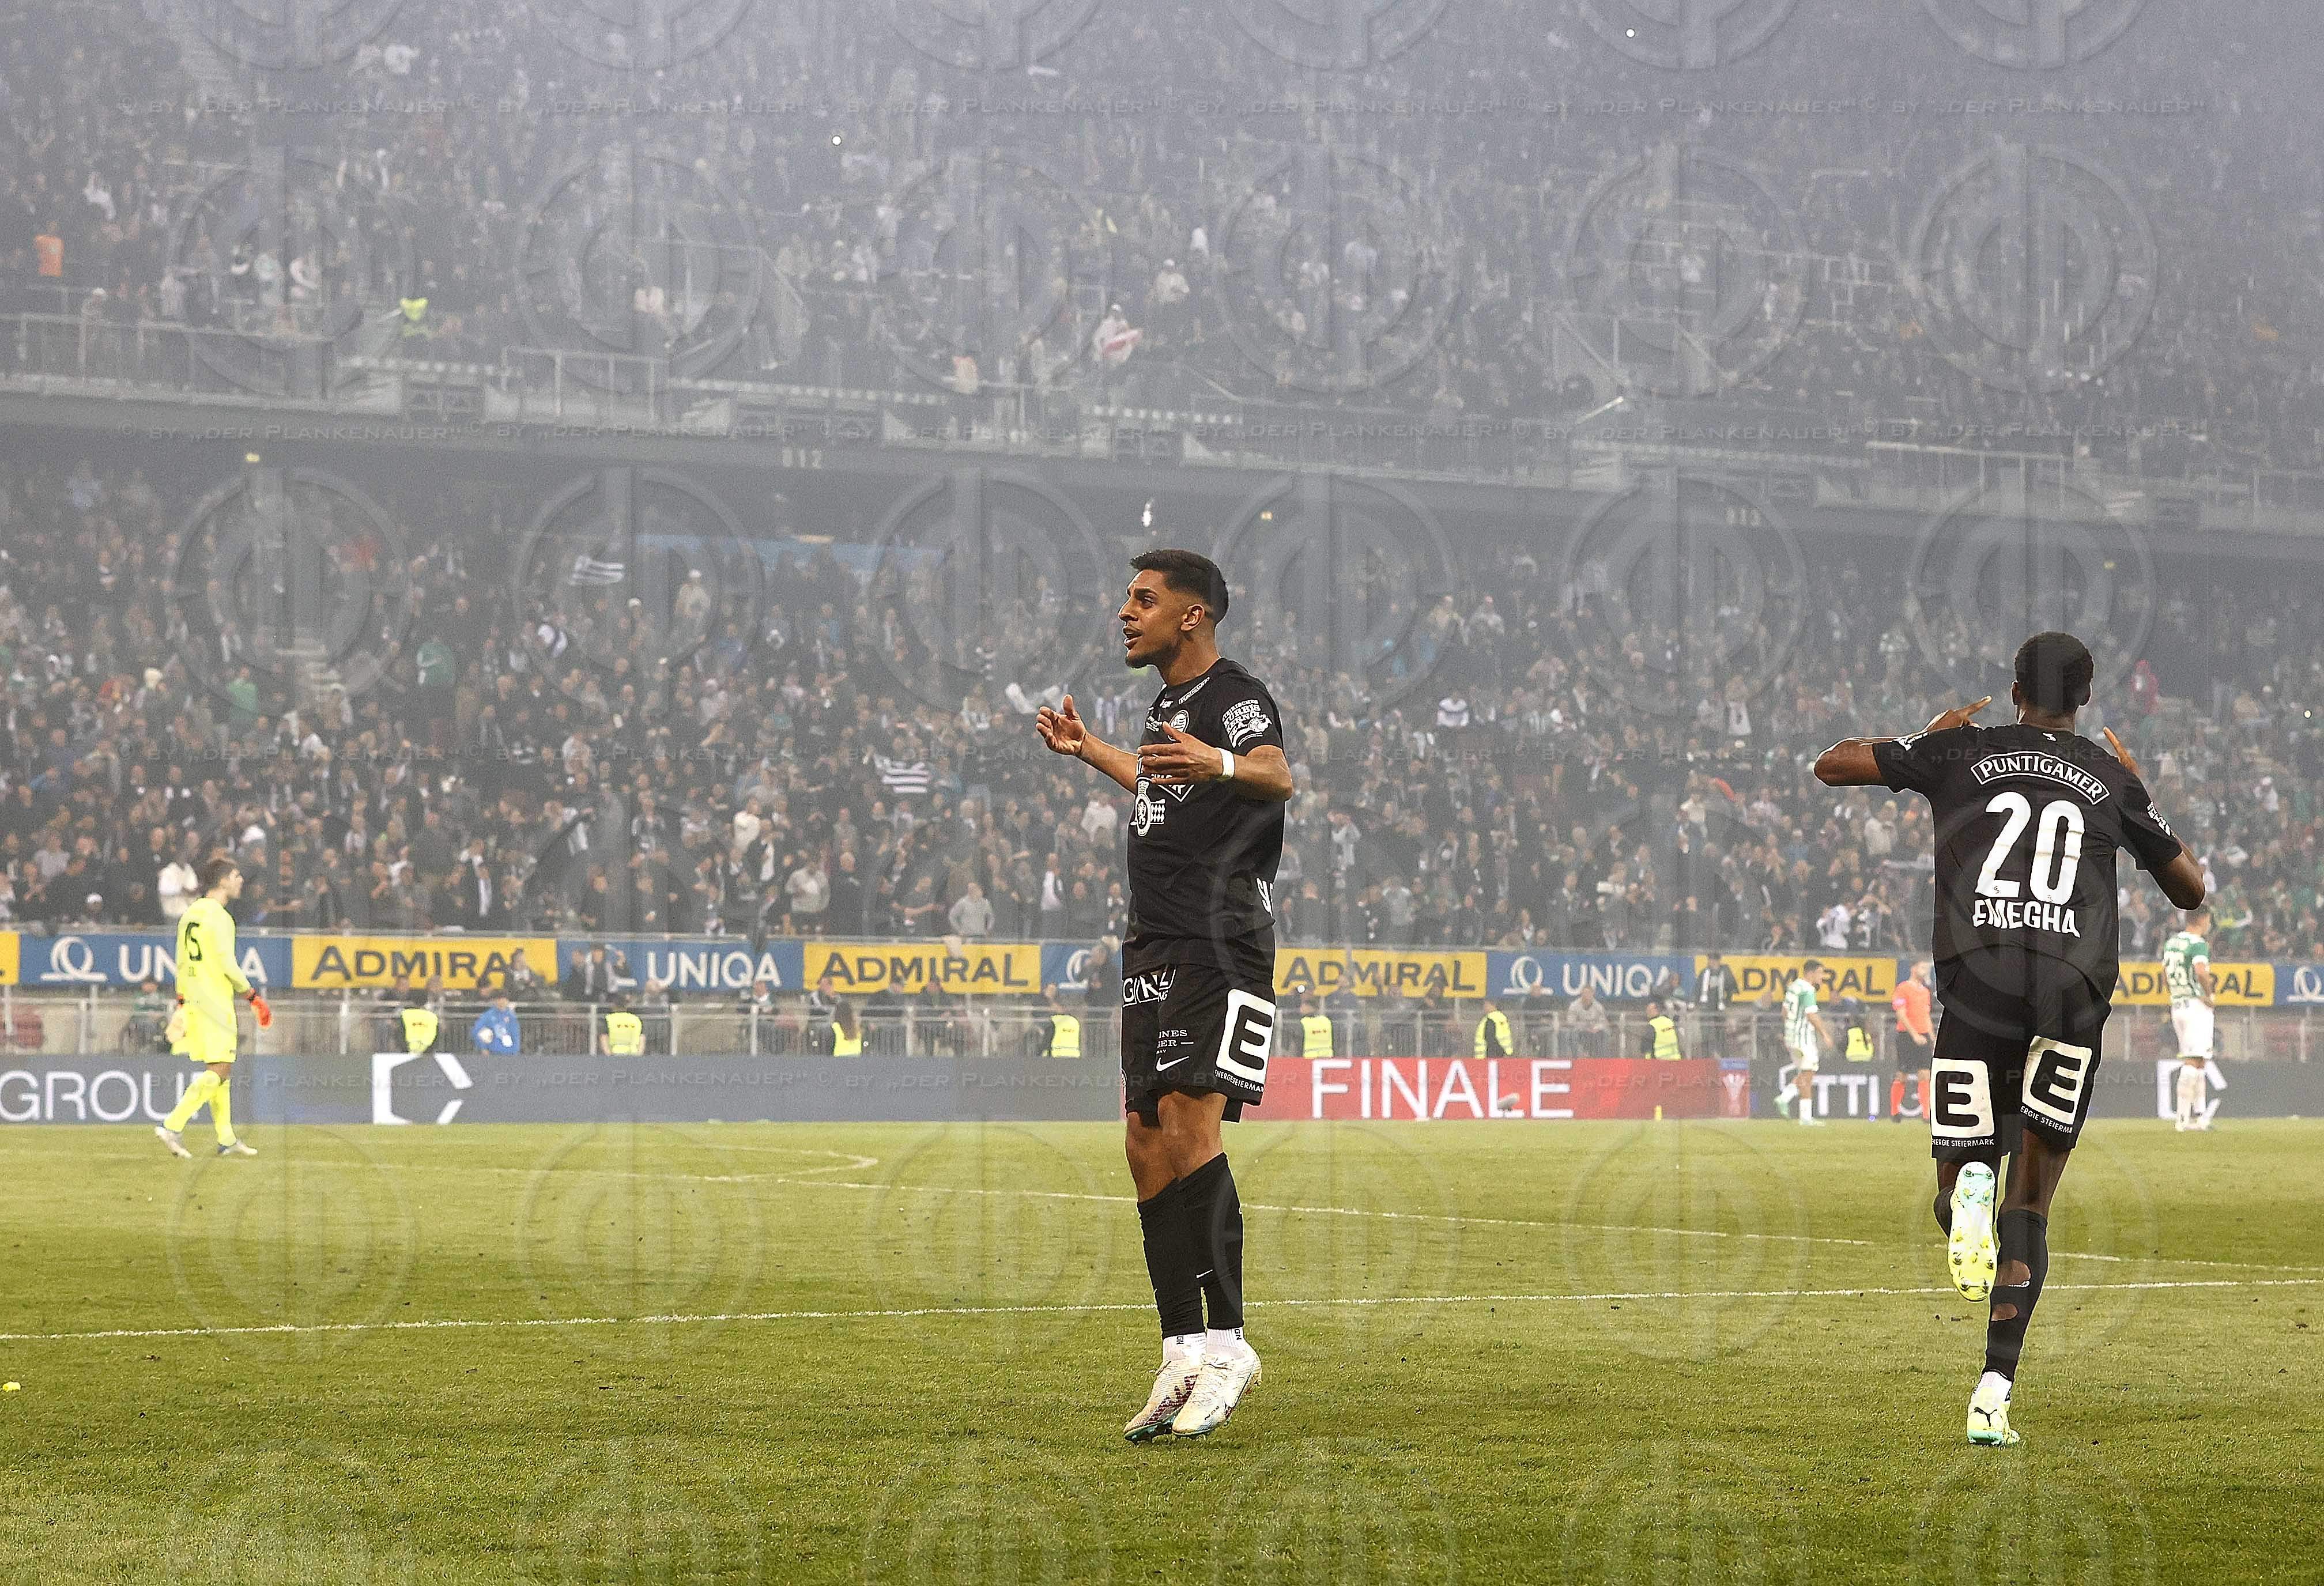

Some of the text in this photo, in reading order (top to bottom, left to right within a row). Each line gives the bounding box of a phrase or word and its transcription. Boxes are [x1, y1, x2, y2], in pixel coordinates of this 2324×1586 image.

[1978, 756, 2103, 798] PUNTIGAMER
[1975, 791, 2086, 905] 20
[1972, 898, 2081, 938] EMEGHA
[311, 945, 513, 987] ADMIRA
[647, 951, 782, 987] UNIQA
[821, 951, 1029, 987] ADMIRAL
[1282, 956, 1477, 991] ADMIRAL
[1229, 1005, 1272, 1070] E
[1311, 1059, 1574, 1119] FINALE
[1935, 1071, 1979, 1127] E
[2030, 1049, 2081, 1113] E
[1951, 1138, 1995, 1147] STEIERMARK
